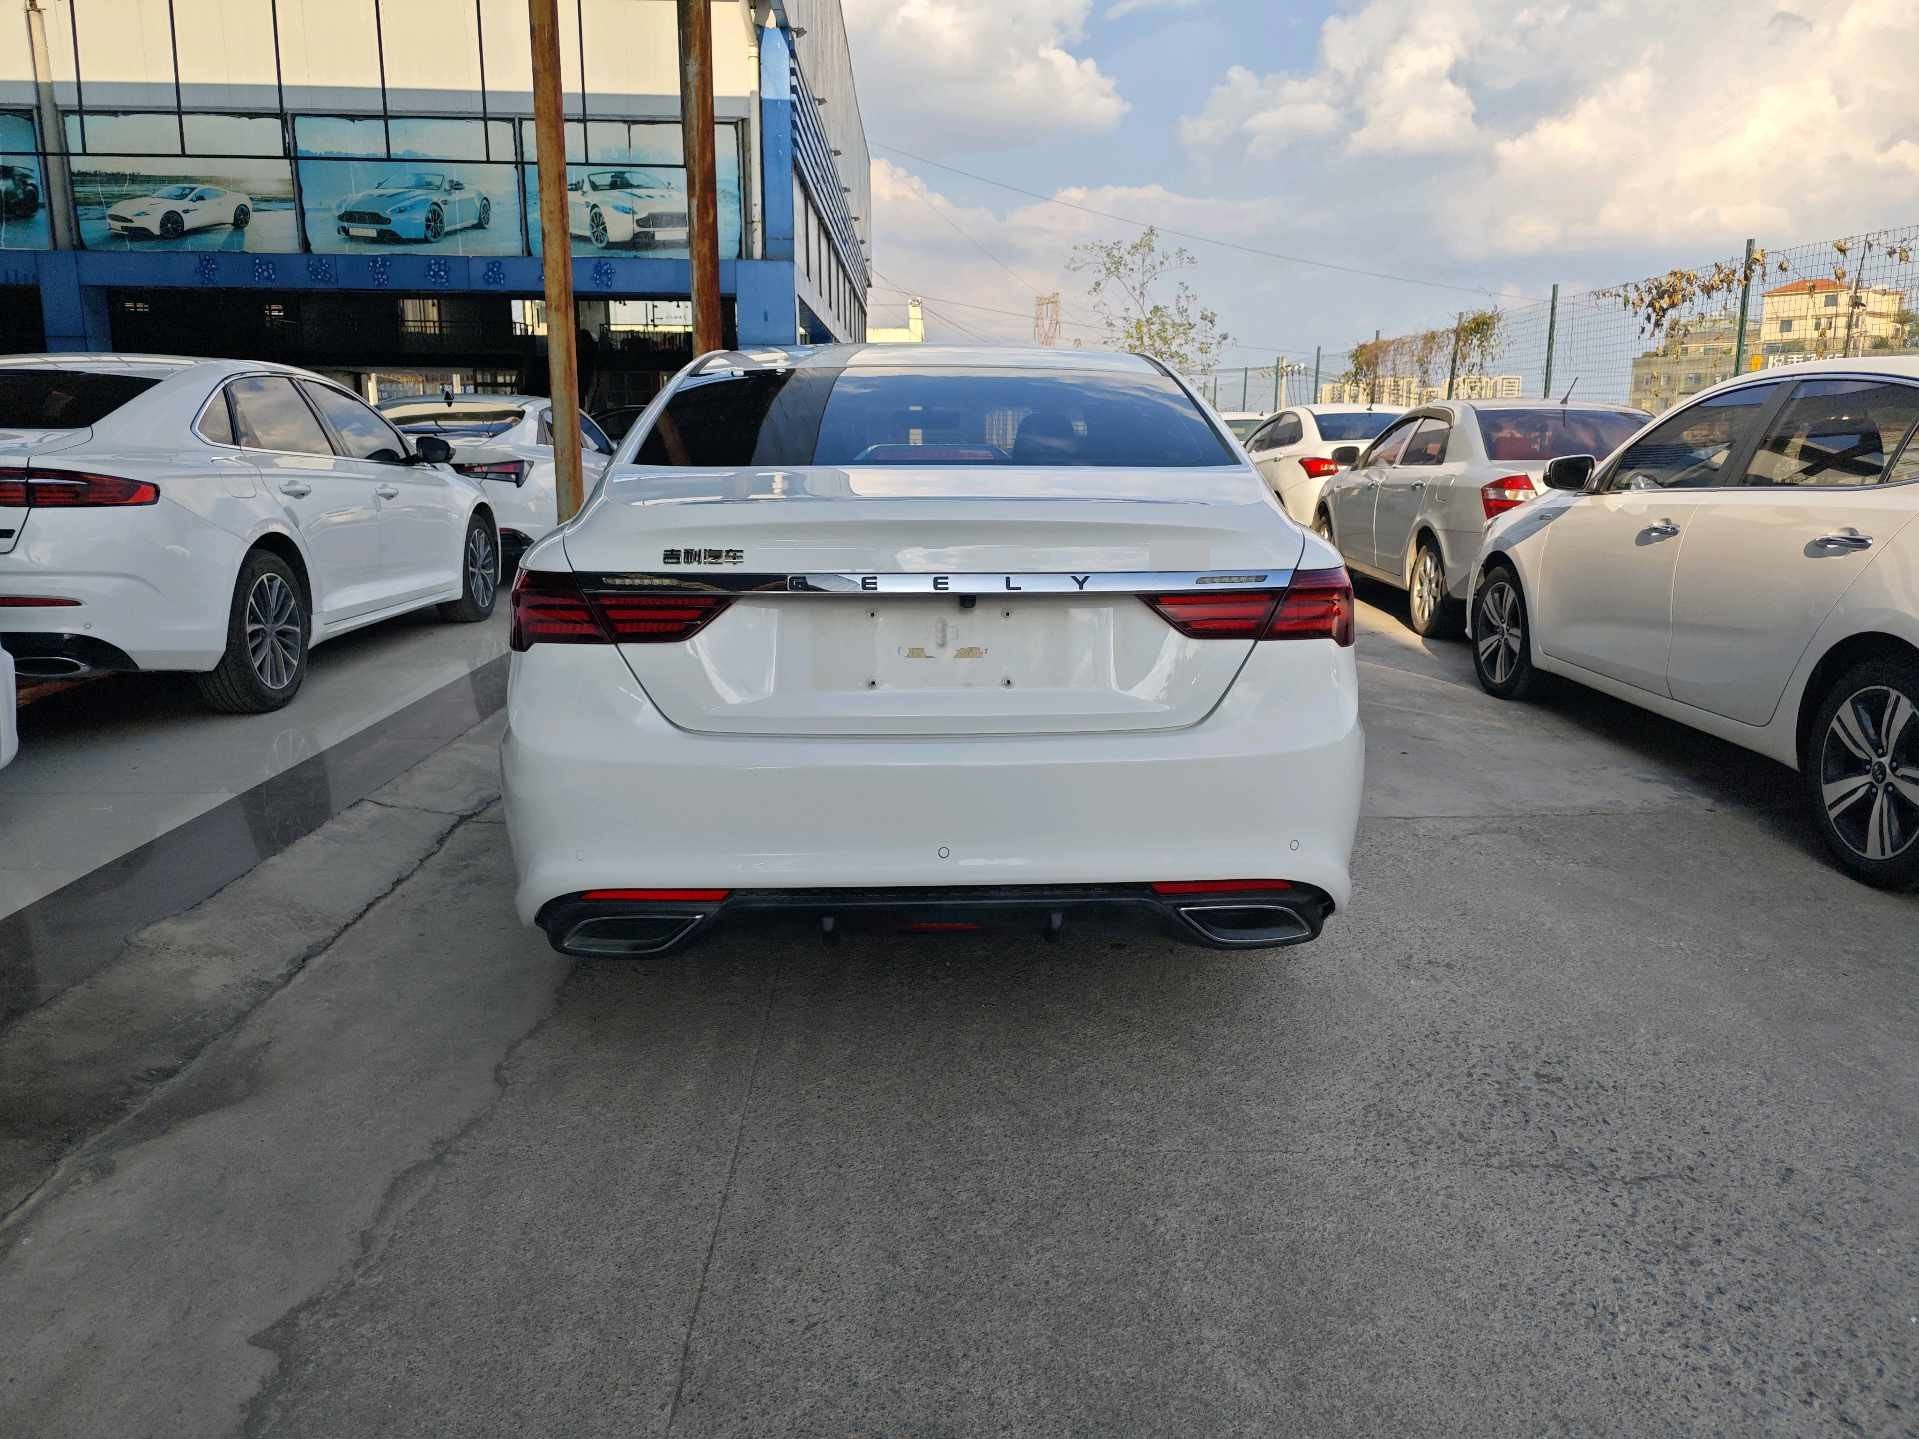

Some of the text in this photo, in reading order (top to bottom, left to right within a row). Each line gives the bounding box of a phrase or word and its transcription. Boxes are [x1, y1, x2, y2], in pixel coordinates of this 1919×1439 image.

[663, 549, 744, 565] 吉利汽车
[787, 575, 1090, 591] GEELY
